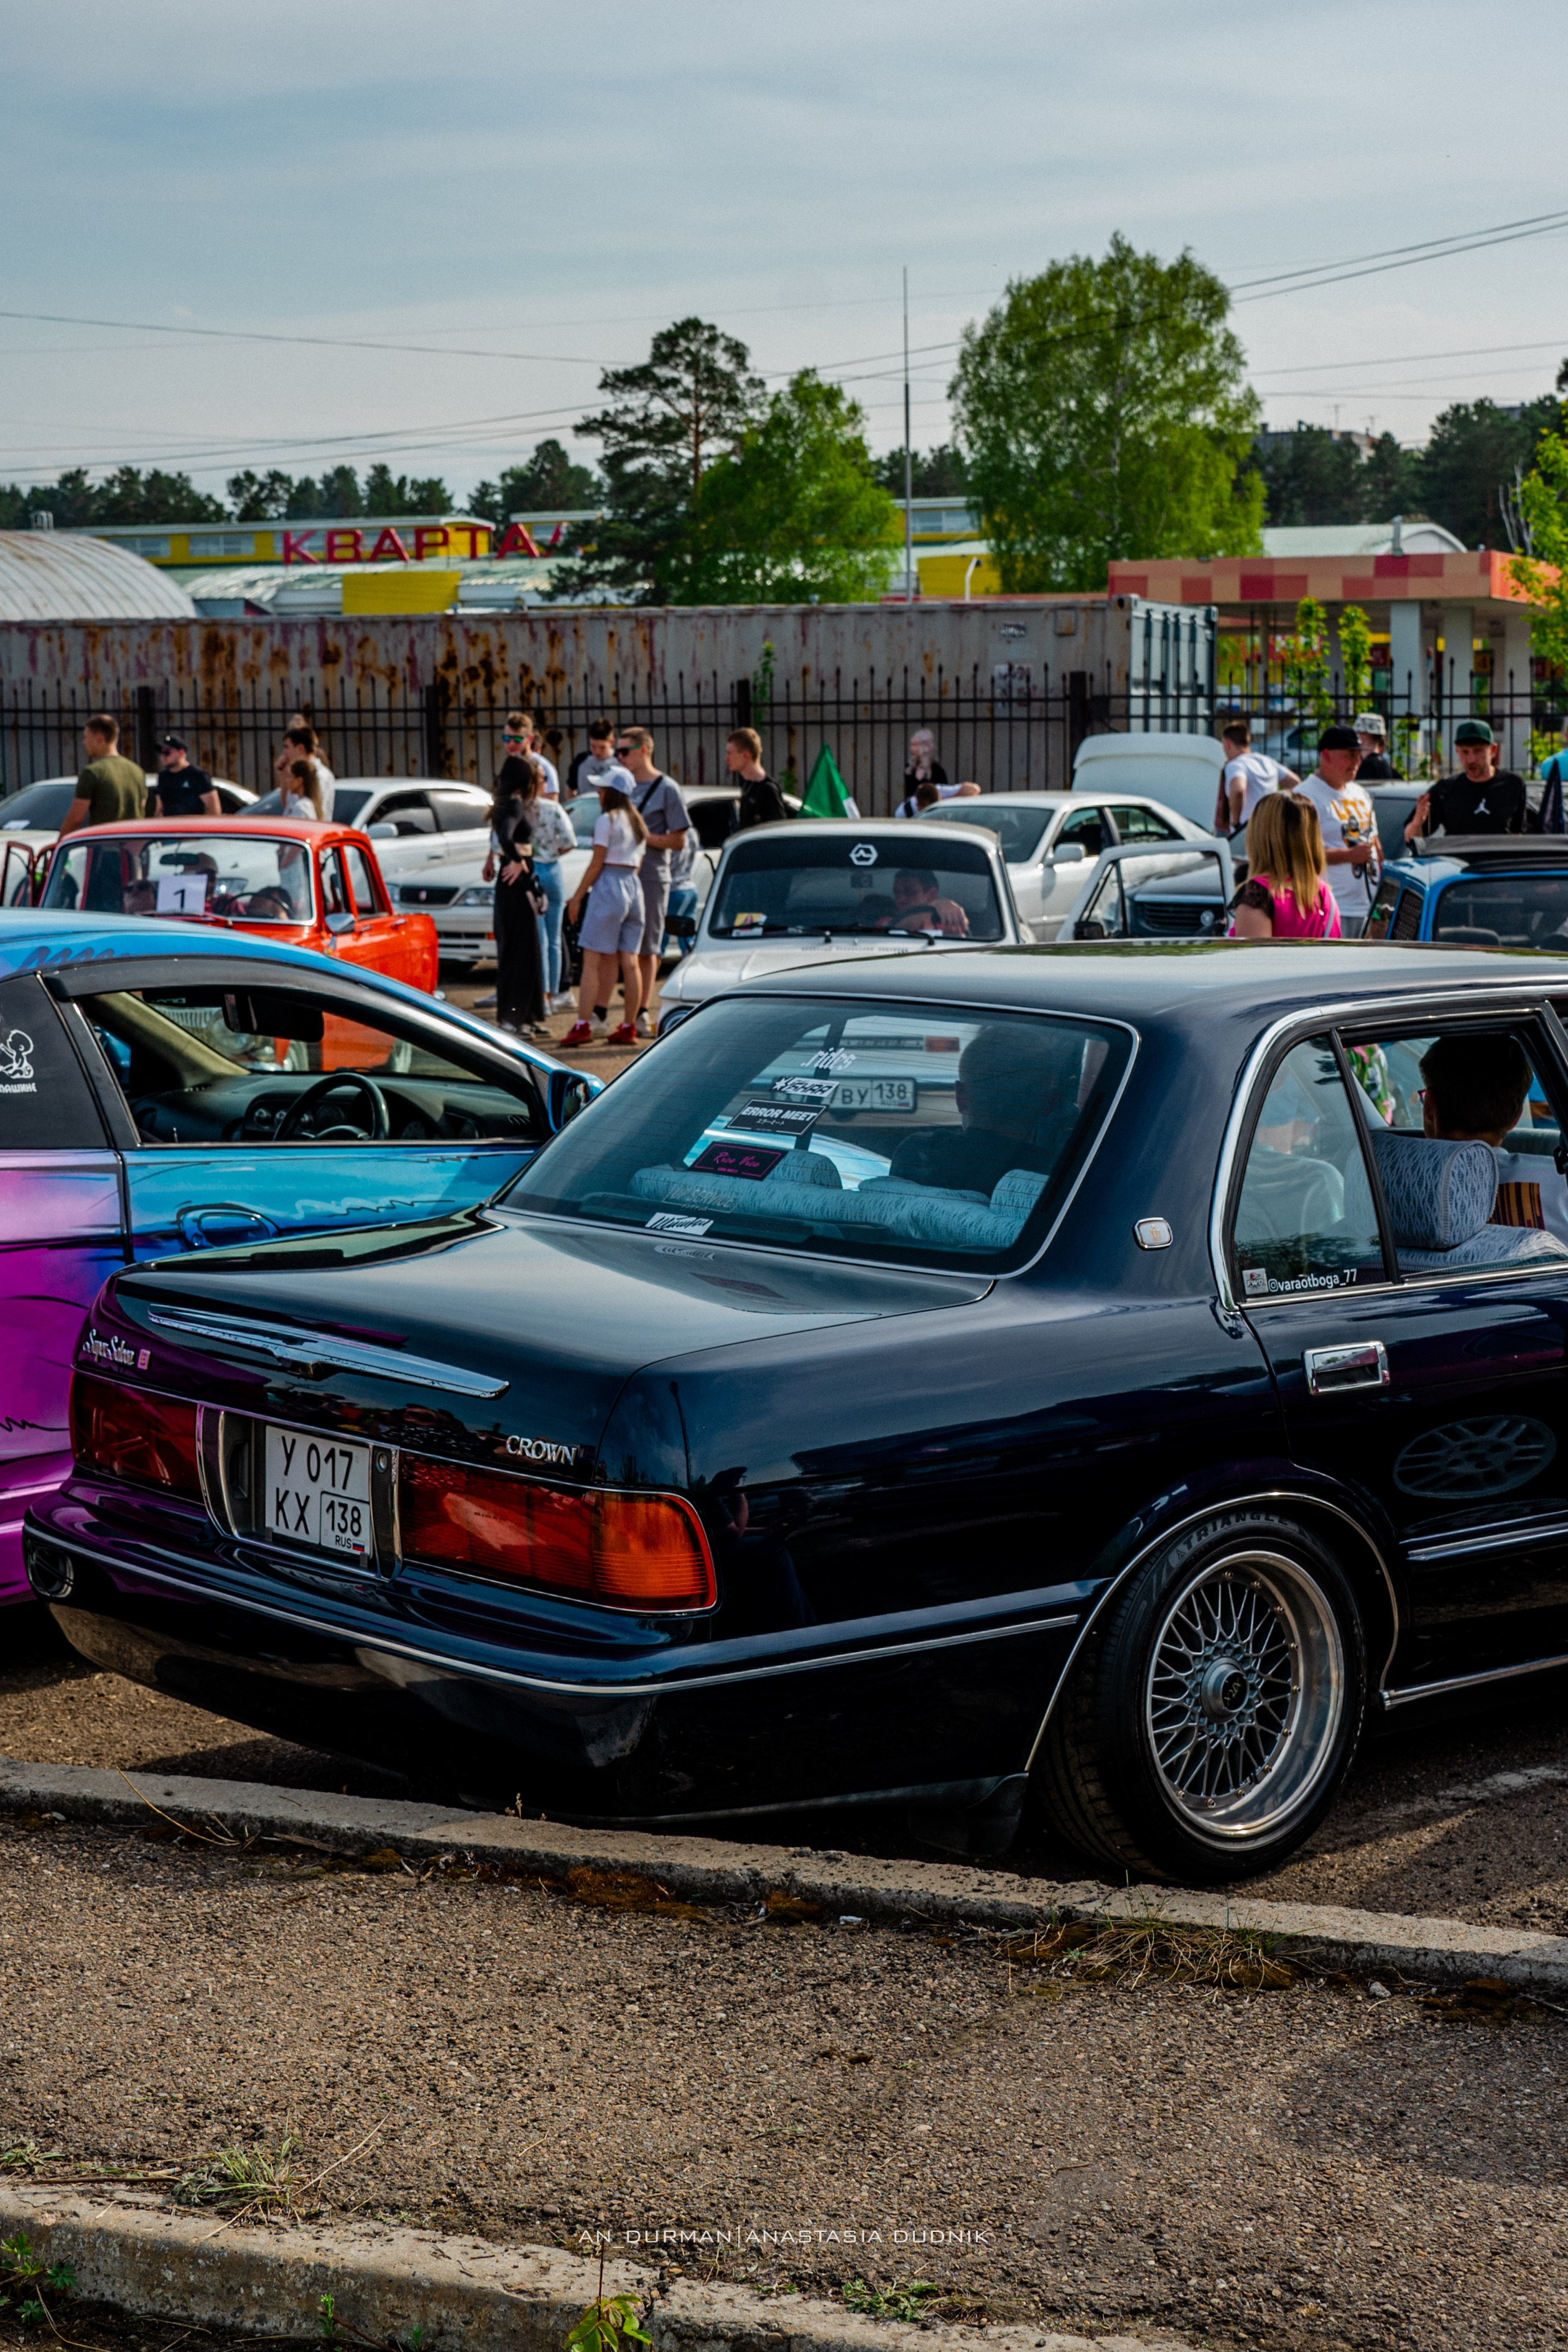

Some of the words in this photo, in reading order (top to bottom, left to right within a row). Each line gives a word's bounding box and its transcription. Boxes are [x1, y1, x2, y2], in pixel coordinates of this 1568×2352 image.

[282, 522, 560, 565] КВАРТА
[174, 888, 185, 909] 1
[874, 1083, 907, 1100] 138
[741, 1106, 784, 1118] ERROR
[781, 1110, 819, 1122] MEET
[506, 1435, 577, 1466] CROWN
[307, 1443, 353, 1490] 017
[325, 1500, 362, 1537] 138
[1183, 1512, 1288, 1551] TRIANGLE
[335, 1535, 352, 1549] RUS
